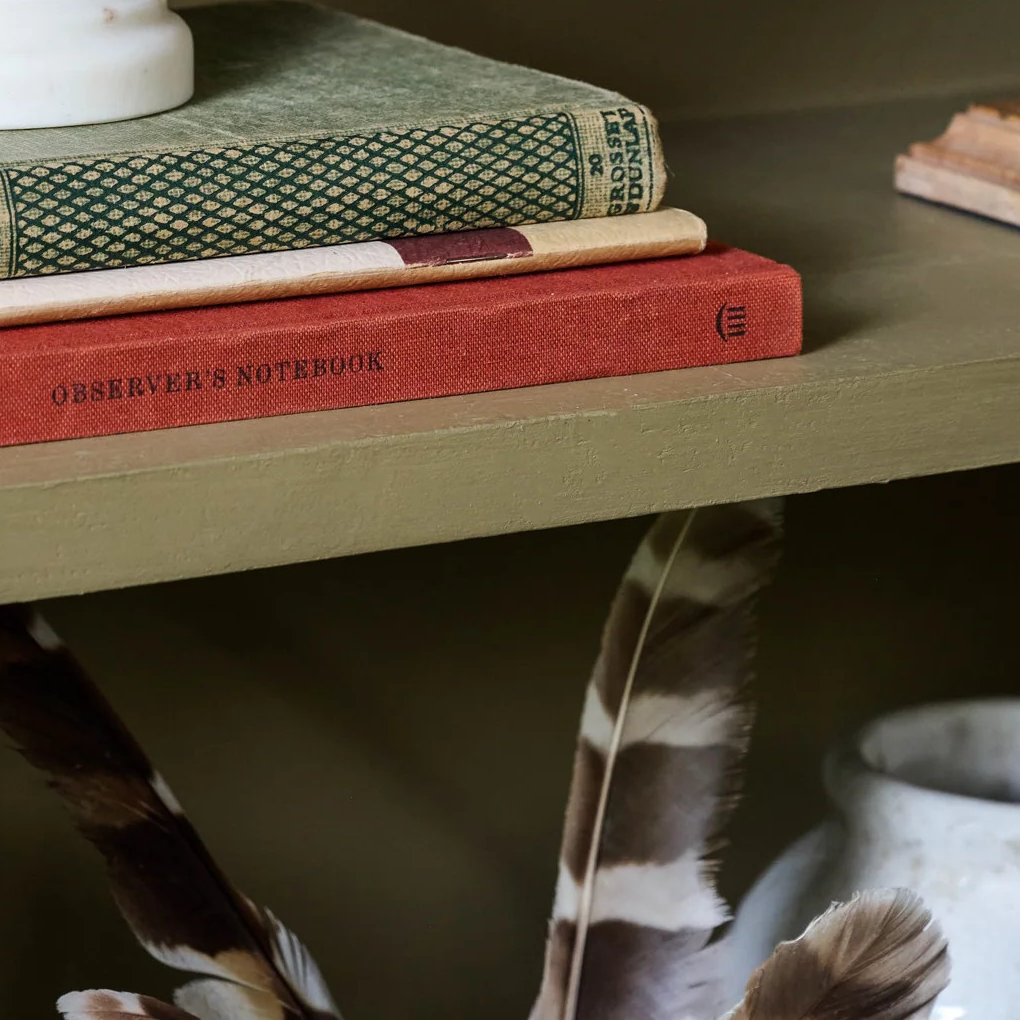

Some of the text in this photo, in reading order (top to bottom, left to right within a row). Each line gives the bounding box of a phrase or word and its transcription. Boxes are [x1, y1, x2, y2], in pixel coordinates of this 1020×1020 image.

[588, 153, 603, 176] 20
[600, 110, 625, 216] GROSSET
[617, 108, 644, 199] DUNLAP
[51, 351, 385, 406] OBSERVER'S NOTEBOOK
